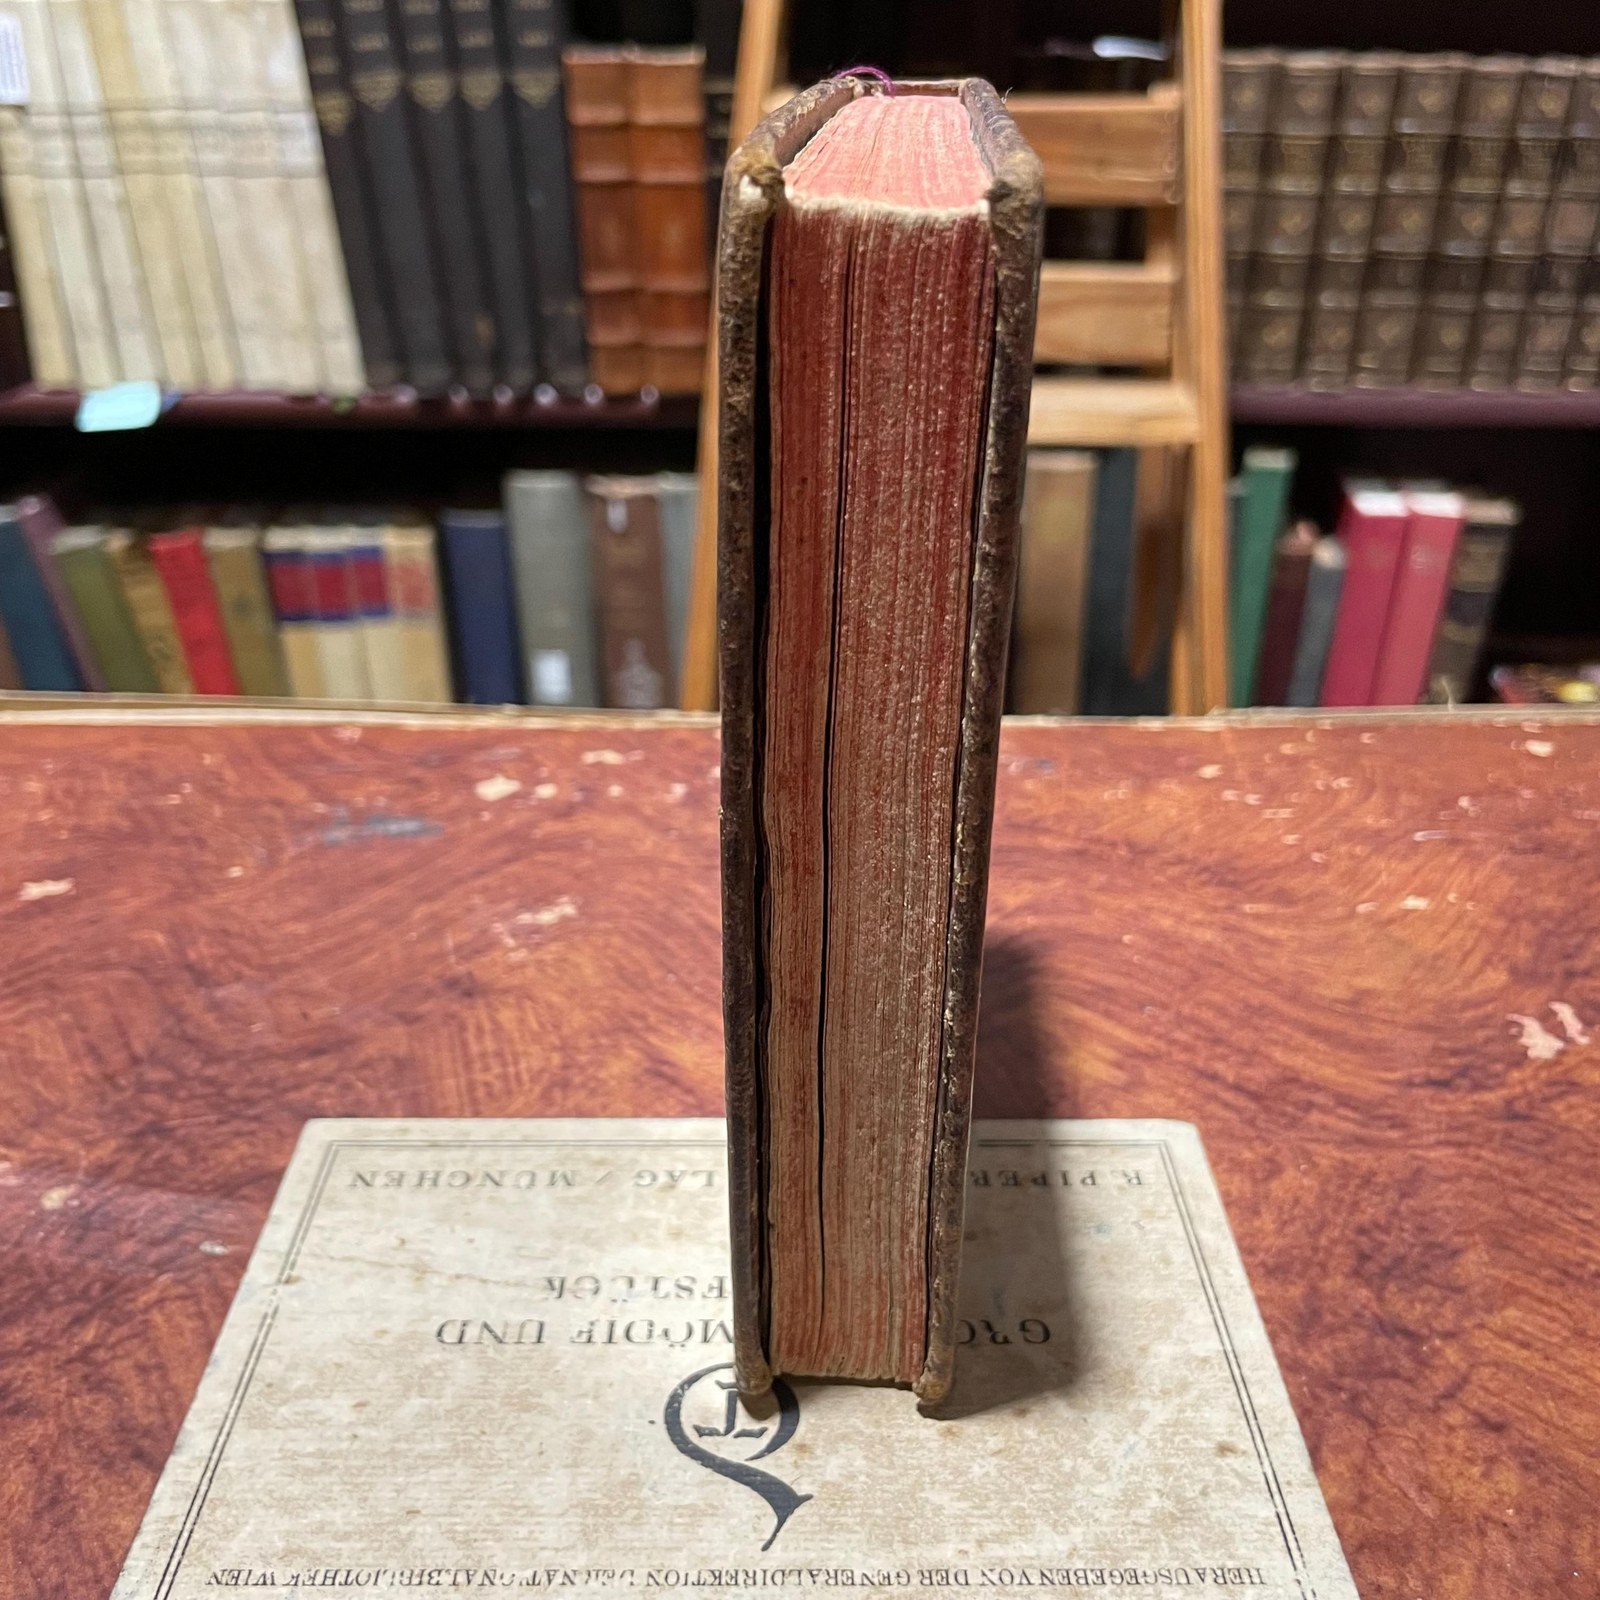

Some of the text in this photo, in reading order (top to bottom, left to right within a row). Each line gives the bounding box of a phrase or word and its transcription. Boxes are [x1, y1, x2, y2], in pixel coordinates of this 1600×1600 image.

[346, 1168, 575, 1188] MÜNCHEN
[632, 1168, 714, 1186] LAG
[967, 1168, 1096, 1186] PIPER
[433, 1317, 544, 1345] UND
[204, 1567, 275, 1586] WIEN
[645, 1567, 910, 1586] GENERALDIREKTION
[917, 1567, 968, 1586] DER
[978, 1567, 1033, 1586] VON
[1038, 1566, 1265, 1585] HERAUSGEGEBEN
